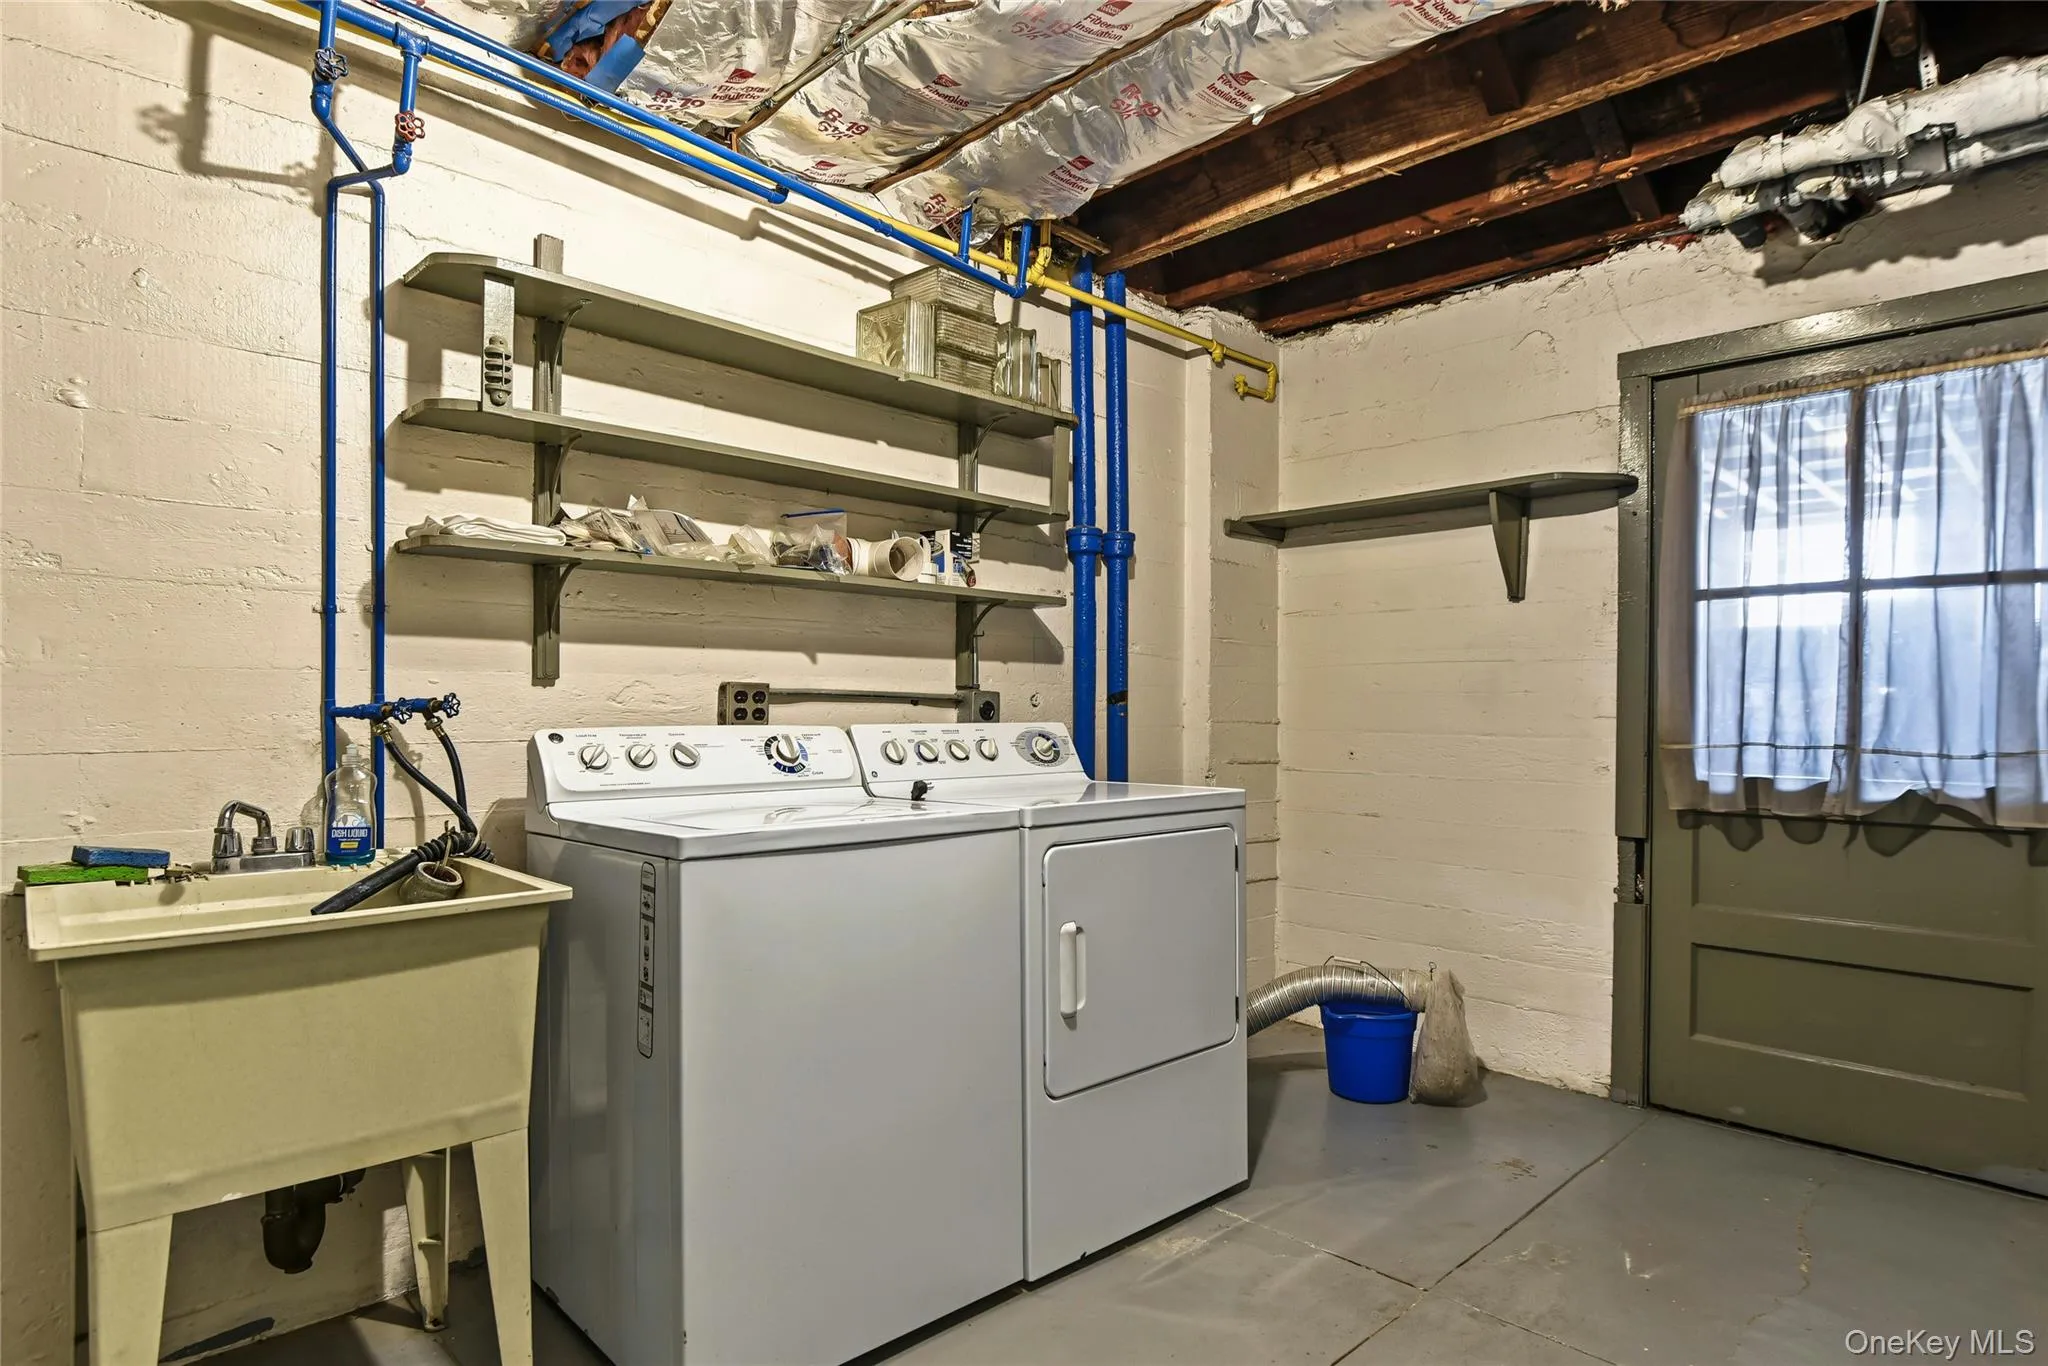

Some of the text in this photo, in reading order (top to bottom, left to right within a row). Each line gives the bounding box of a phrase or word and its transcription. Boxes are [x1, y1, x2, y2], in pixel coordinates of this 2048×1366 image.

[1072, 21, 1123, 41] Insulation
[1207, 82, 1247, 110] Insulation
[823, 108, 869, 135] R-19
[332, 829, 368, 838] DISH LIQUID
